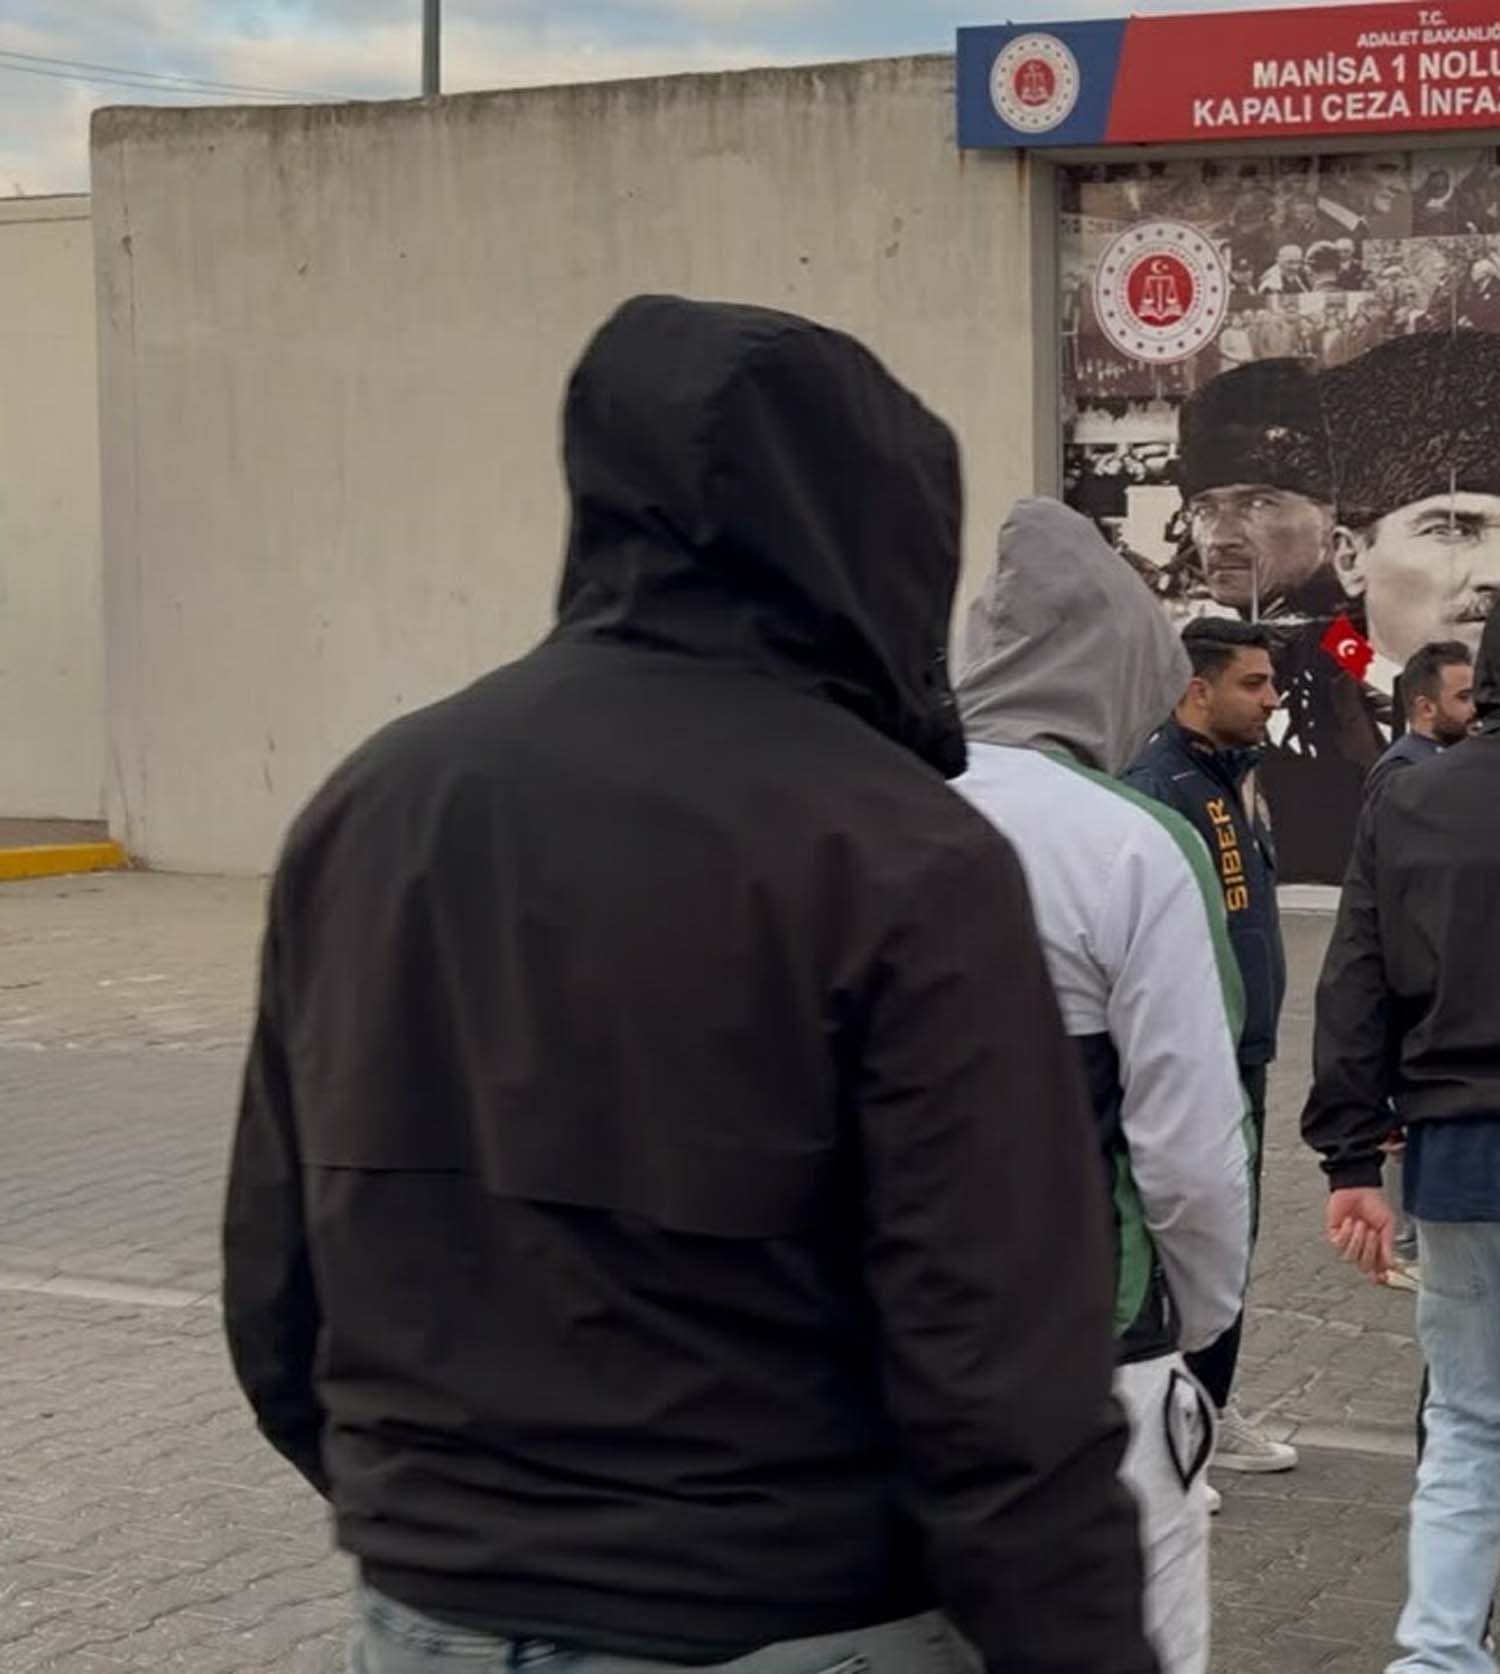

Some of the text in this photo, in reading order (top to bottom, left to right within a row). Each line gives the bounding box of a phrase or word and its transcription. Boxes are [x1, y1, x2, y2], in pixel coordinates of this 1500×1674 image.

[1357, 29, 1420, 47] ADALET
[1253, 52, 1381, 88] MANİSA
[1391, 53, 1405, 82] 1
[1193, 95, 1311, 127] KAPALI
[1321, 90, 1410, 122] CEZA
